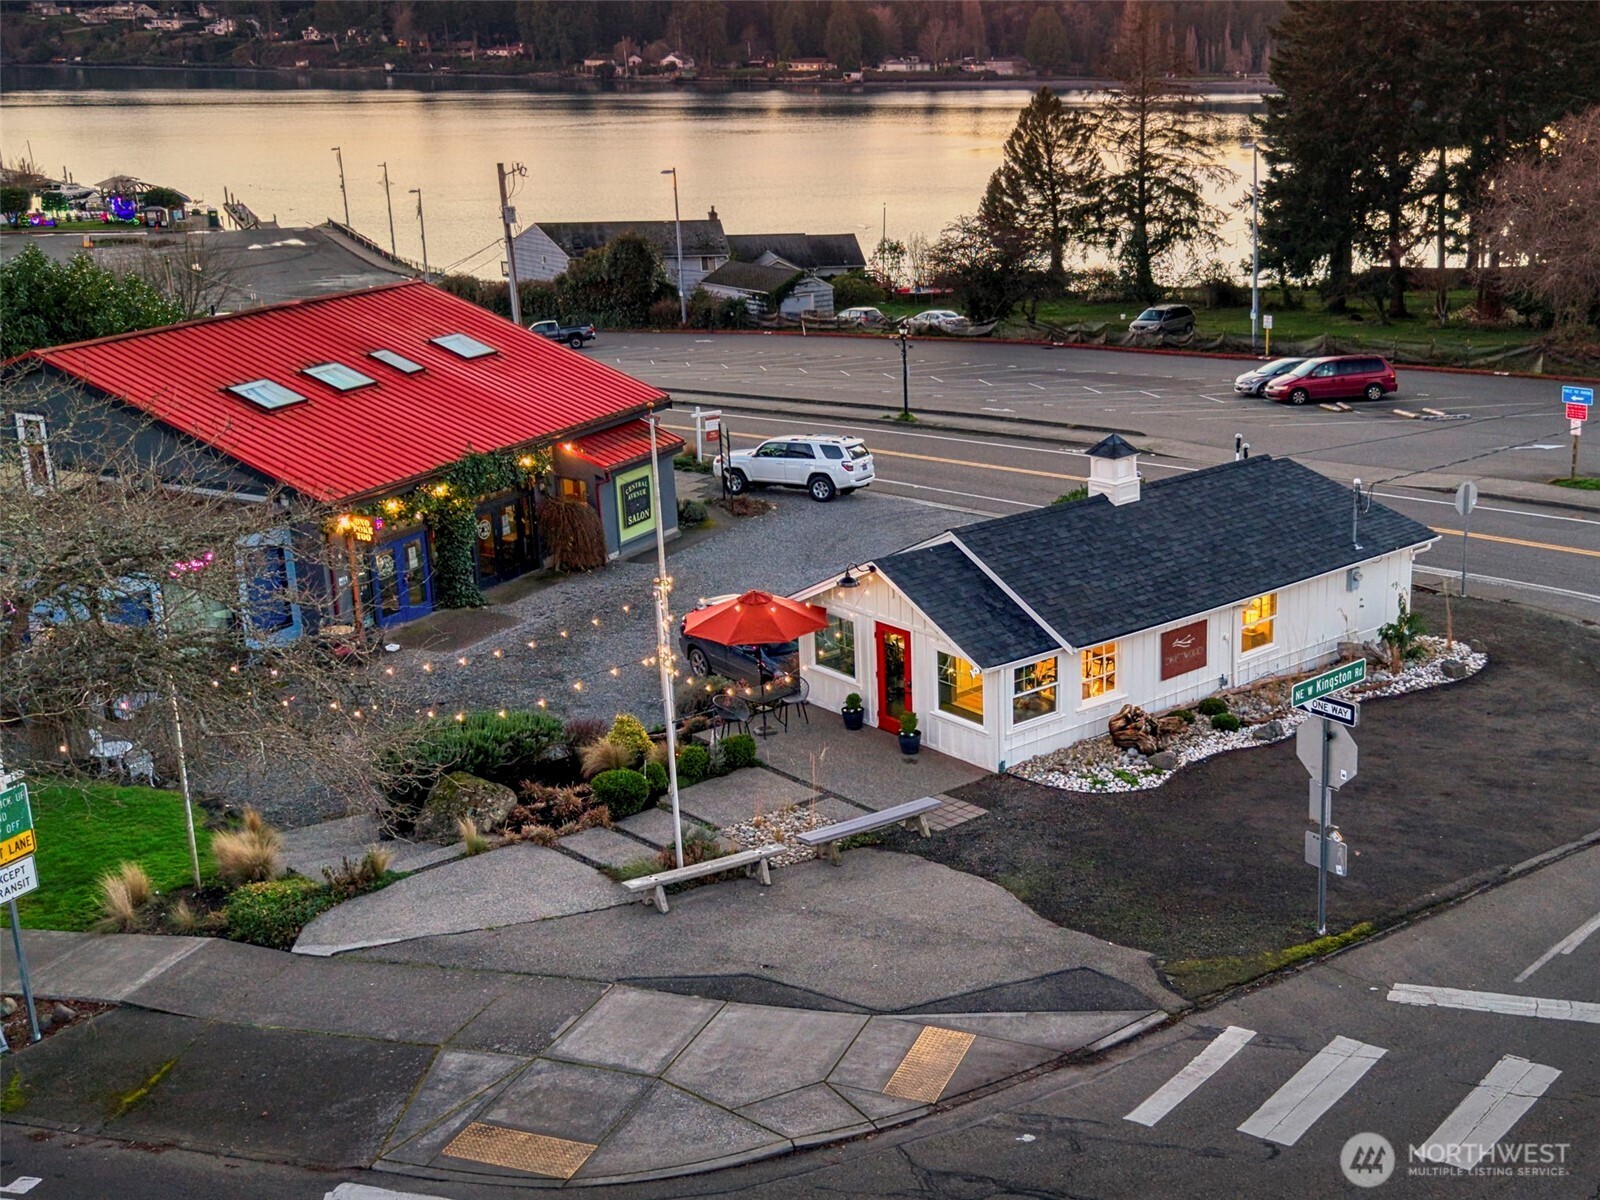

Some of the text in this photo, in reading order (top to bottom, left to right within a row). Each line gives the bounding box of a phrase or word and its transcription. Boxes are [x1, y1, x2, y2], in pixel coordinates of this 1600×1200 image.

[625, 480, 648, 495] CENTRAL
[628, 488, 647, 501] AVENUE
[628, 509, 650, 525] SALON
[356, 532, 372, 541] TOO
[1295, 666, 1363, 701] NE W Kingston Rd
[1312, 700, 1349, 718] ONE WAY
[6, 820, 20, 833] OFF
[8, 835, 32, 854] LANE
[0, 865, 26, 884] XCEPT
[0, 876, 31, 898] RANSIT
